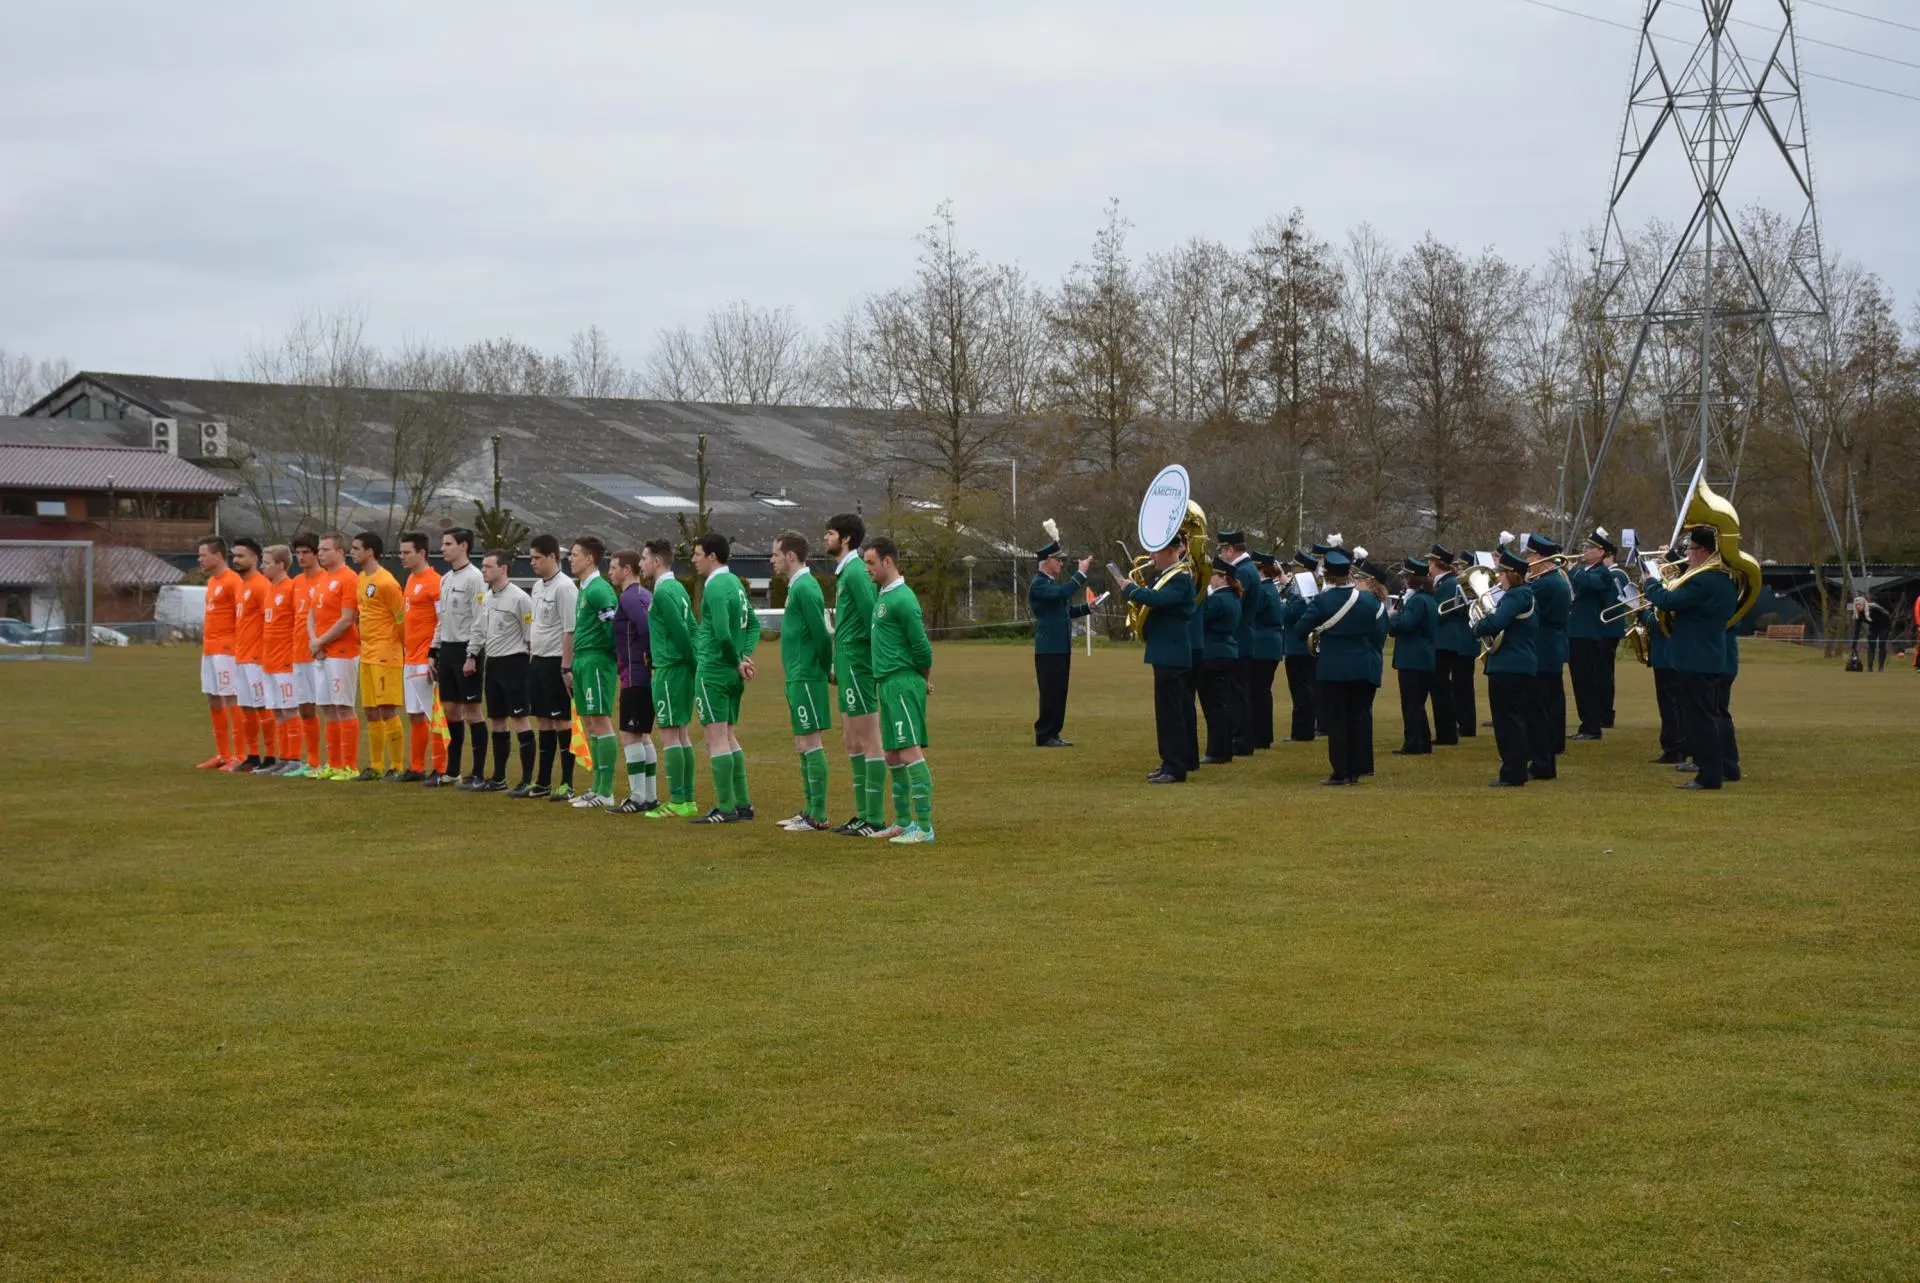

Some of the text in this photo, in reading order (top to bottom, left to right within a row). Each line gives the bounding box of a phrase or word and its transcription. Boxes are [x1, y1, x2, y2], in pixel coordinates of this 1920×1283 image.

[1152, 487, 1182, 497] AMICITIA
[739, 589, 748, 629] 3
[218, 670, 231, 685] 15
[379, 675, 385, 692] 1
[280, 682, 293, 699] 10
[332, 679, 341, 694] 3
[585, 687, 594, 704] 4
[845, 688, 856, 705] 8
[657, 700, 666, 717] 2
[695, 697, 704, 714] 3
[798, 706, 808, 722] 9
[895, 720, 904, 736] 7
